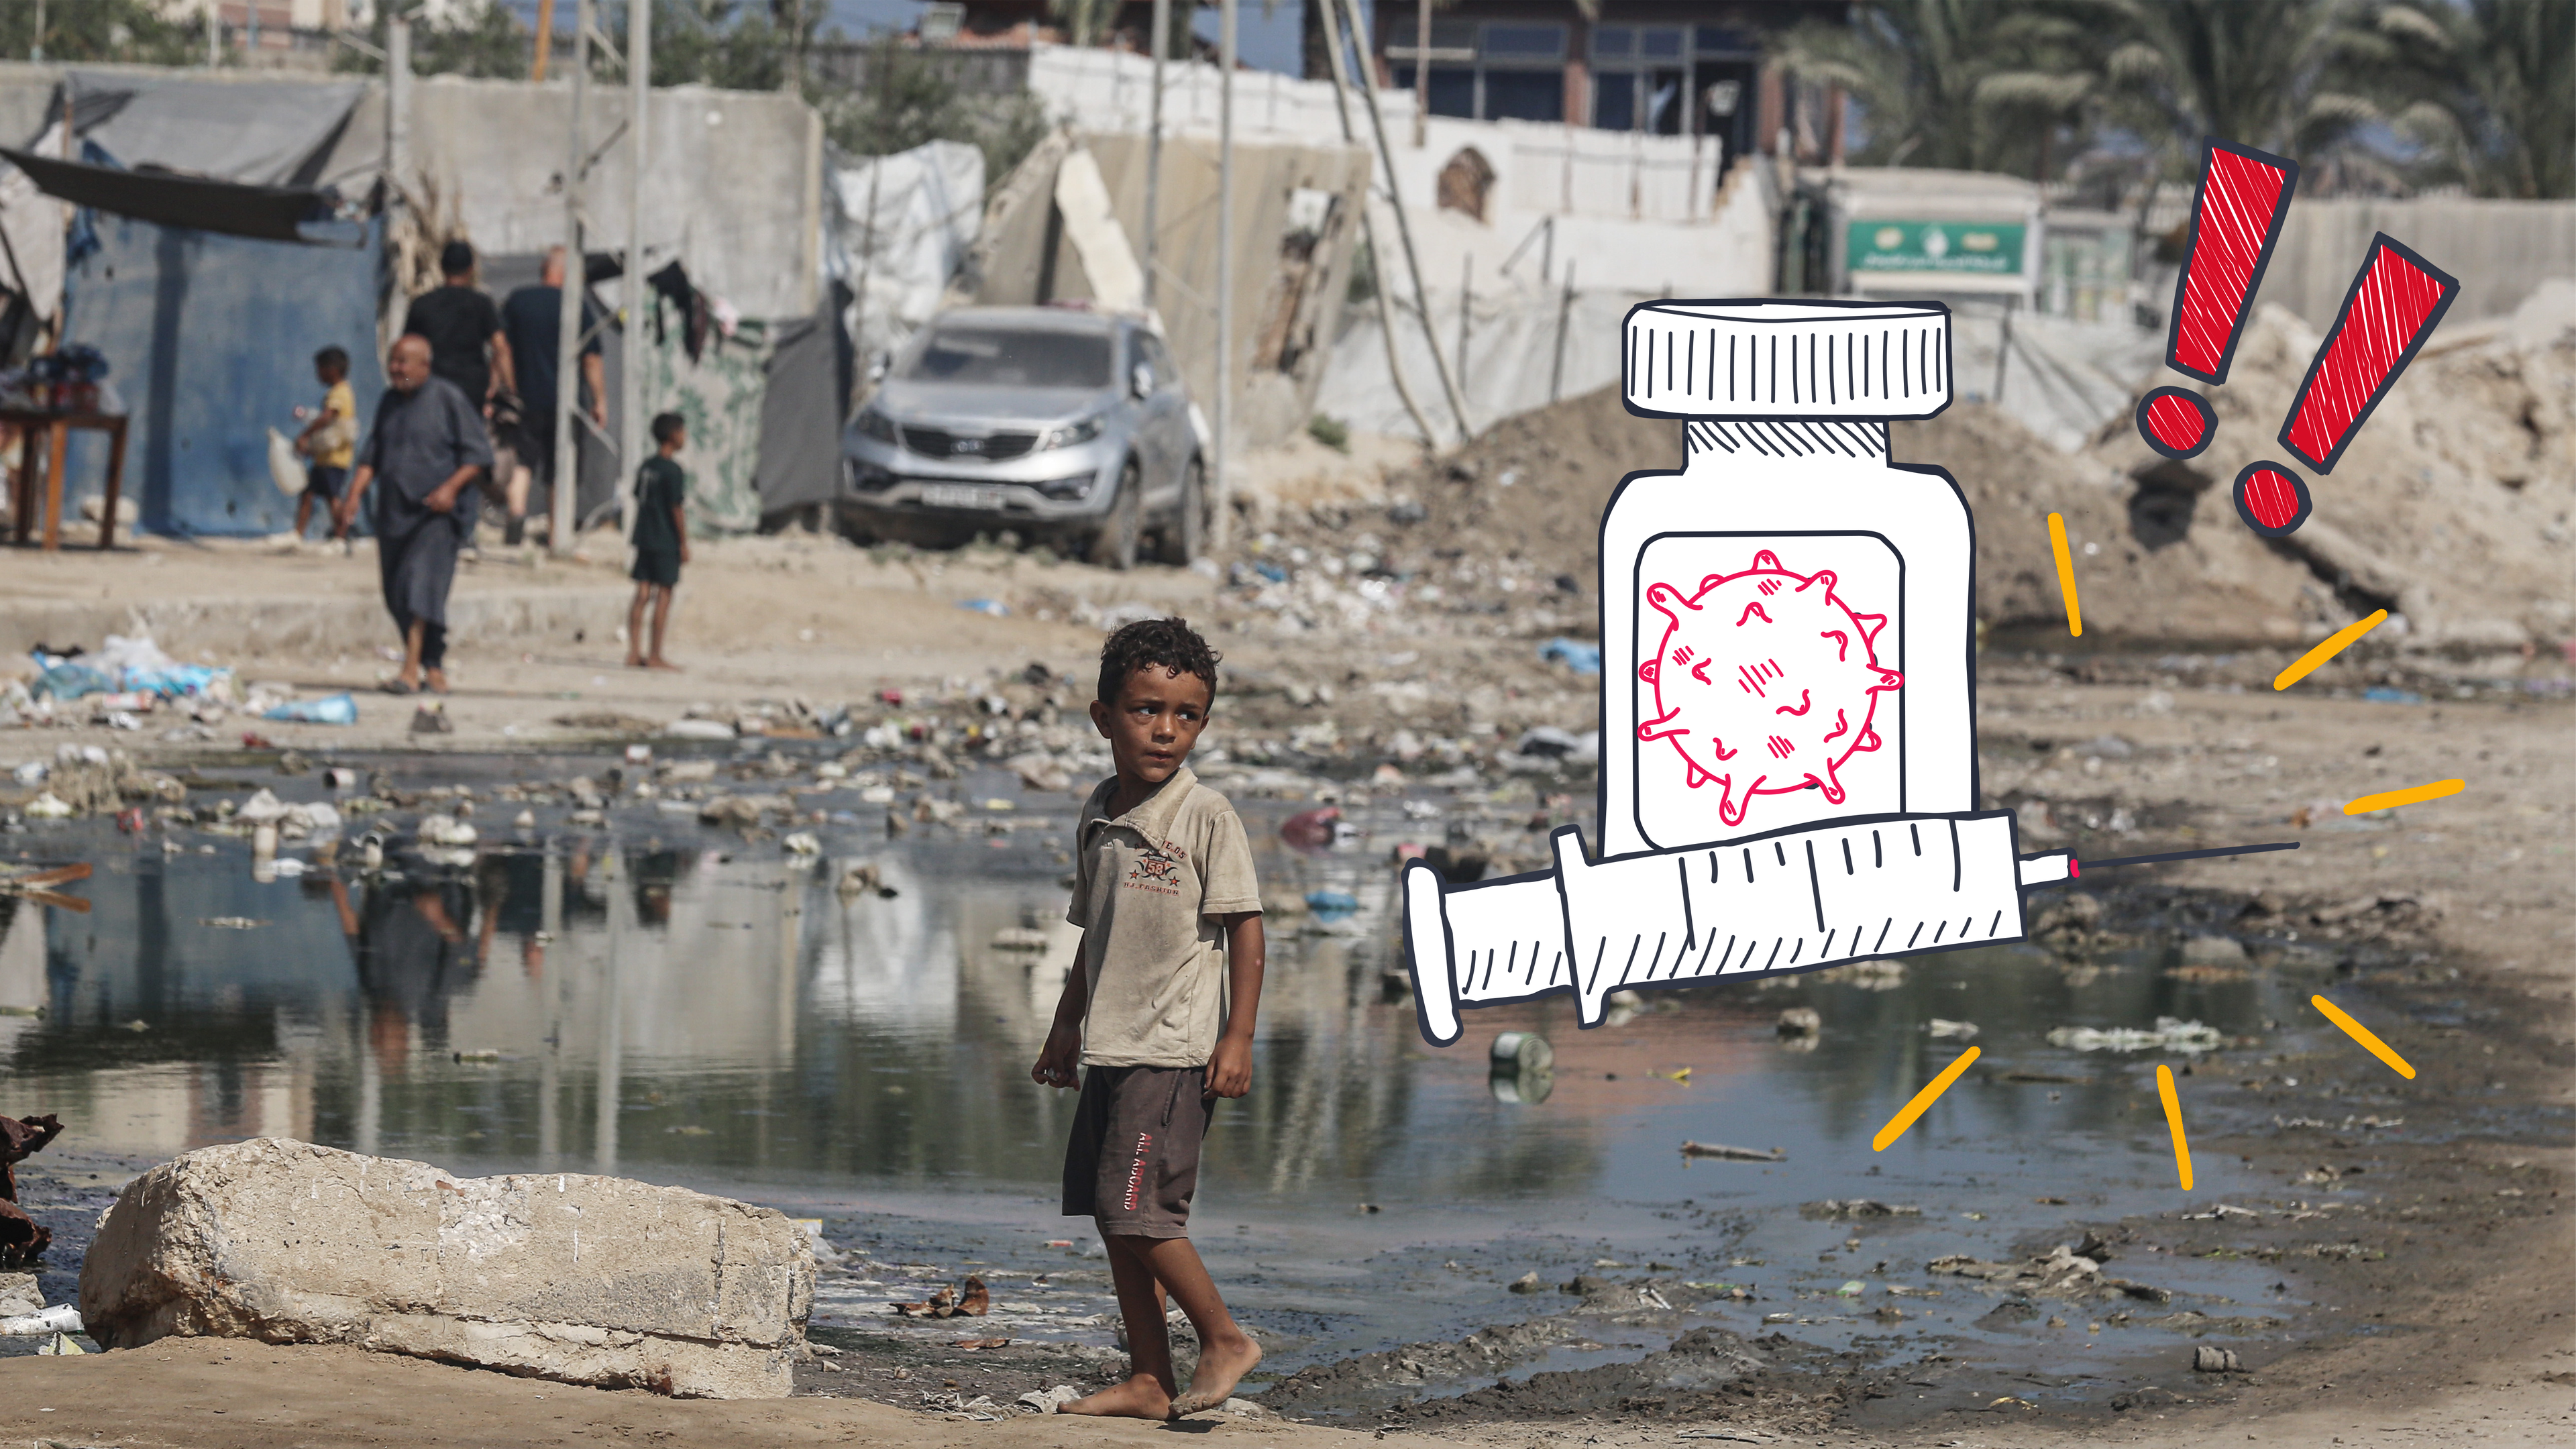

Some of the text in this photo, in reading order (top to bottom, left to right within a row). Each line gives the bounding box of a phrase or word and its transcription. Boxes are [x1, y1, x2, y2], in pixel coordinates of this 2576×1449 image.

[1148, 862, 1164, 875] 58
[1124, 1132, 1152, 1210] ALL ABOARD
